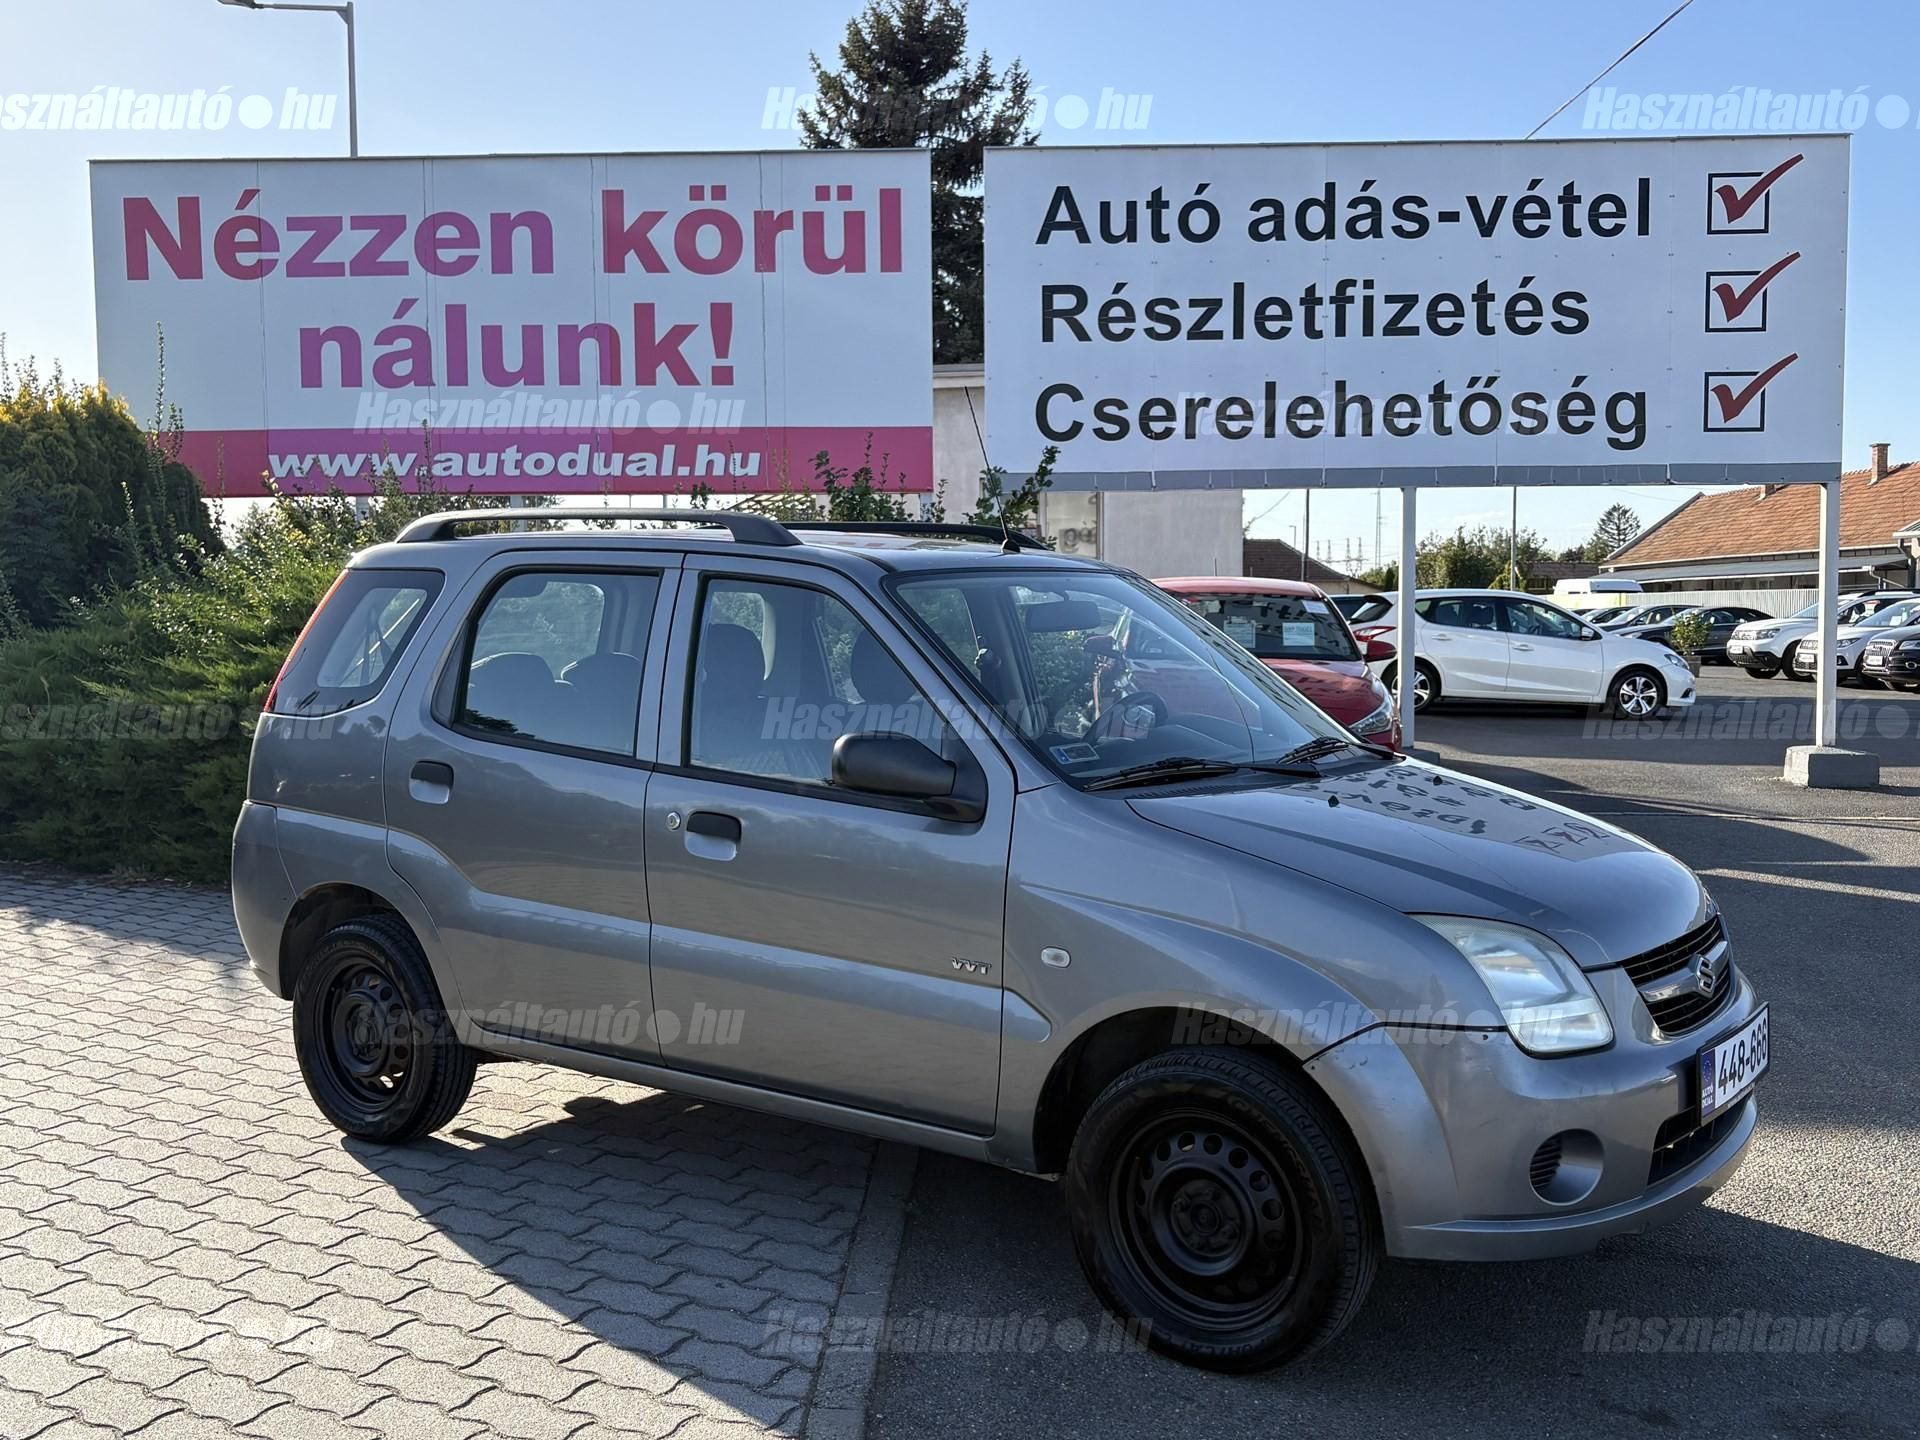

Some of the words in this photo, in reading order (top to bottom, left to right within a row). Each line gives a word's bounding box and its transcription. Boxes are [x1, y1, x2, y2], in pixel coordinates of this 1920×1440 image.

[122, 189, 555, 281] Nézzen
[602, 184, 903, 276] körül
[1035, 182, 1223, 245] Autó
[1247, 177, 1651, 242] adás-vétel
[299, 298, 735, 390] nálunk!
[1040, 275, 1590, 343] Részletfizetés
[1035, 374, 1649, 451] Cserelehetőség
[268, 444, 761, 477] www.autodual.hu
